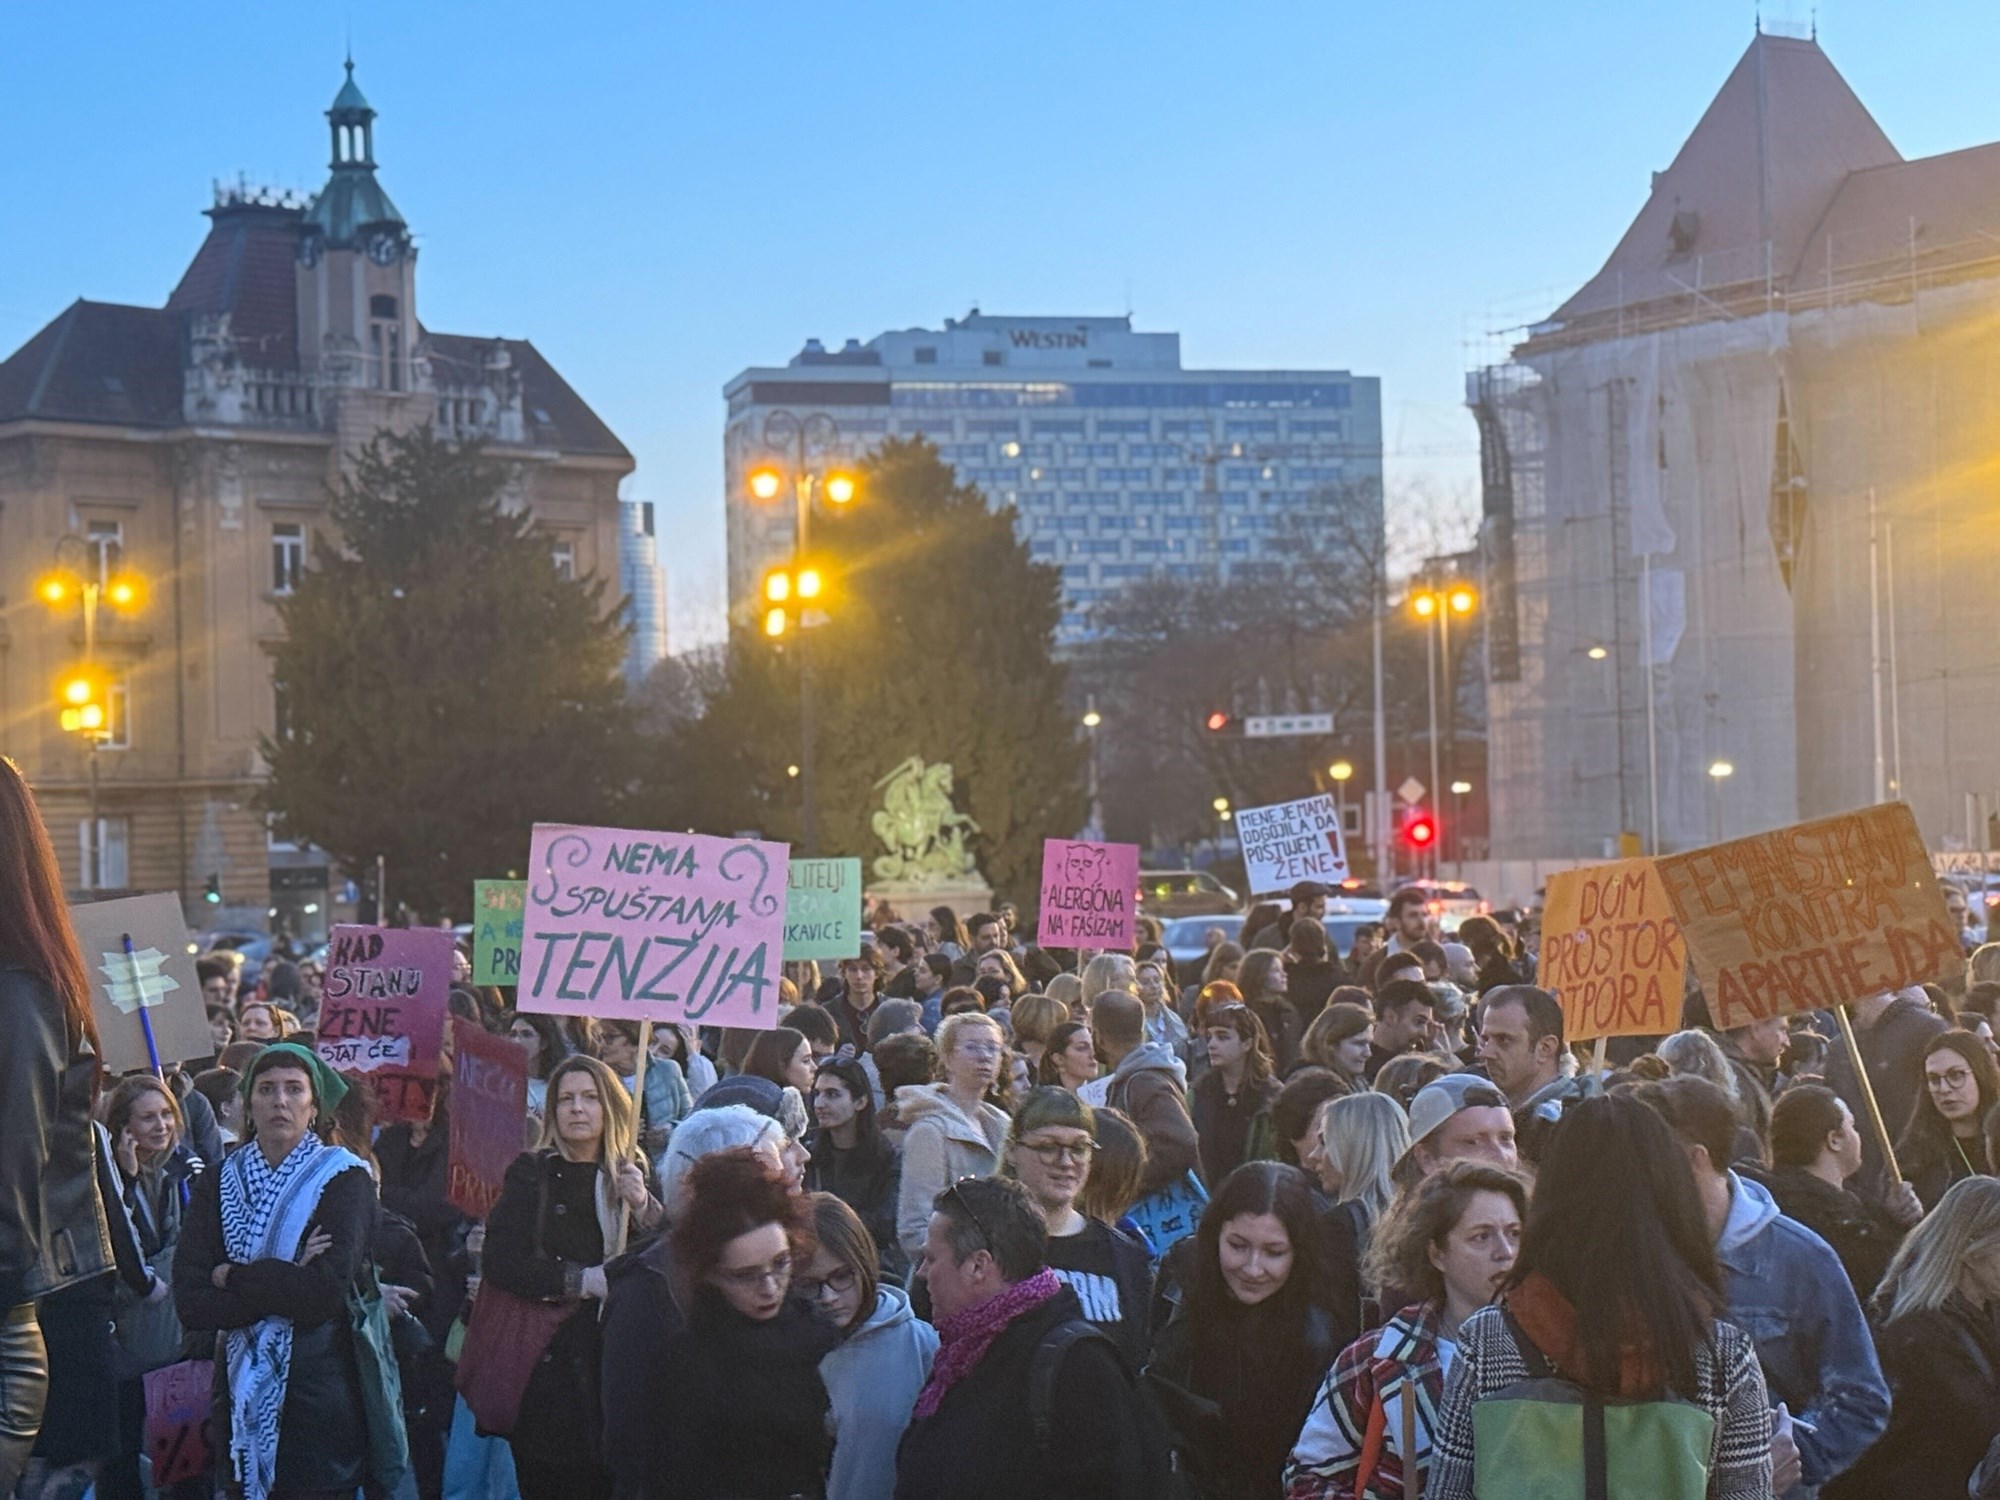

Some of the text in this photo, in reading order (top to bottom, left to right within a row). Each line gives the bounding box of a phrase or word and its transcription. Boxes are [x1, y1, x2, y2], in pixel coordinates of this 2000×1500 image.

[1008, 328, 1087, 350] WESTIN
[1240, 797, 1335, 828] MENE JE MAMA
[1243, 814, 1336, 845] ODGOJILA DA
[603, 842, 699, 879] NEMA
[1246, 834, 1321, 864] POŠTUJEM
[551, 885, 742, 938] SPUŠTANJA
[1579, 869, 1646, 926] DOM
[1047, 913, 1124, 937] NA FAŠIZAM
[1741, 873, 1906, 957] KONTRA
[334, 934, 384, 966] KAD
[1543, 916, 1680, 988] PROSTOR
[327, 968, 421, 999] STANU
[531, 931, 772, 1019] TENZIJA
[1717, 918, 1967, 1026] APARTHEJDA
[321, 1040, 399, 1062] STAT ĆE
